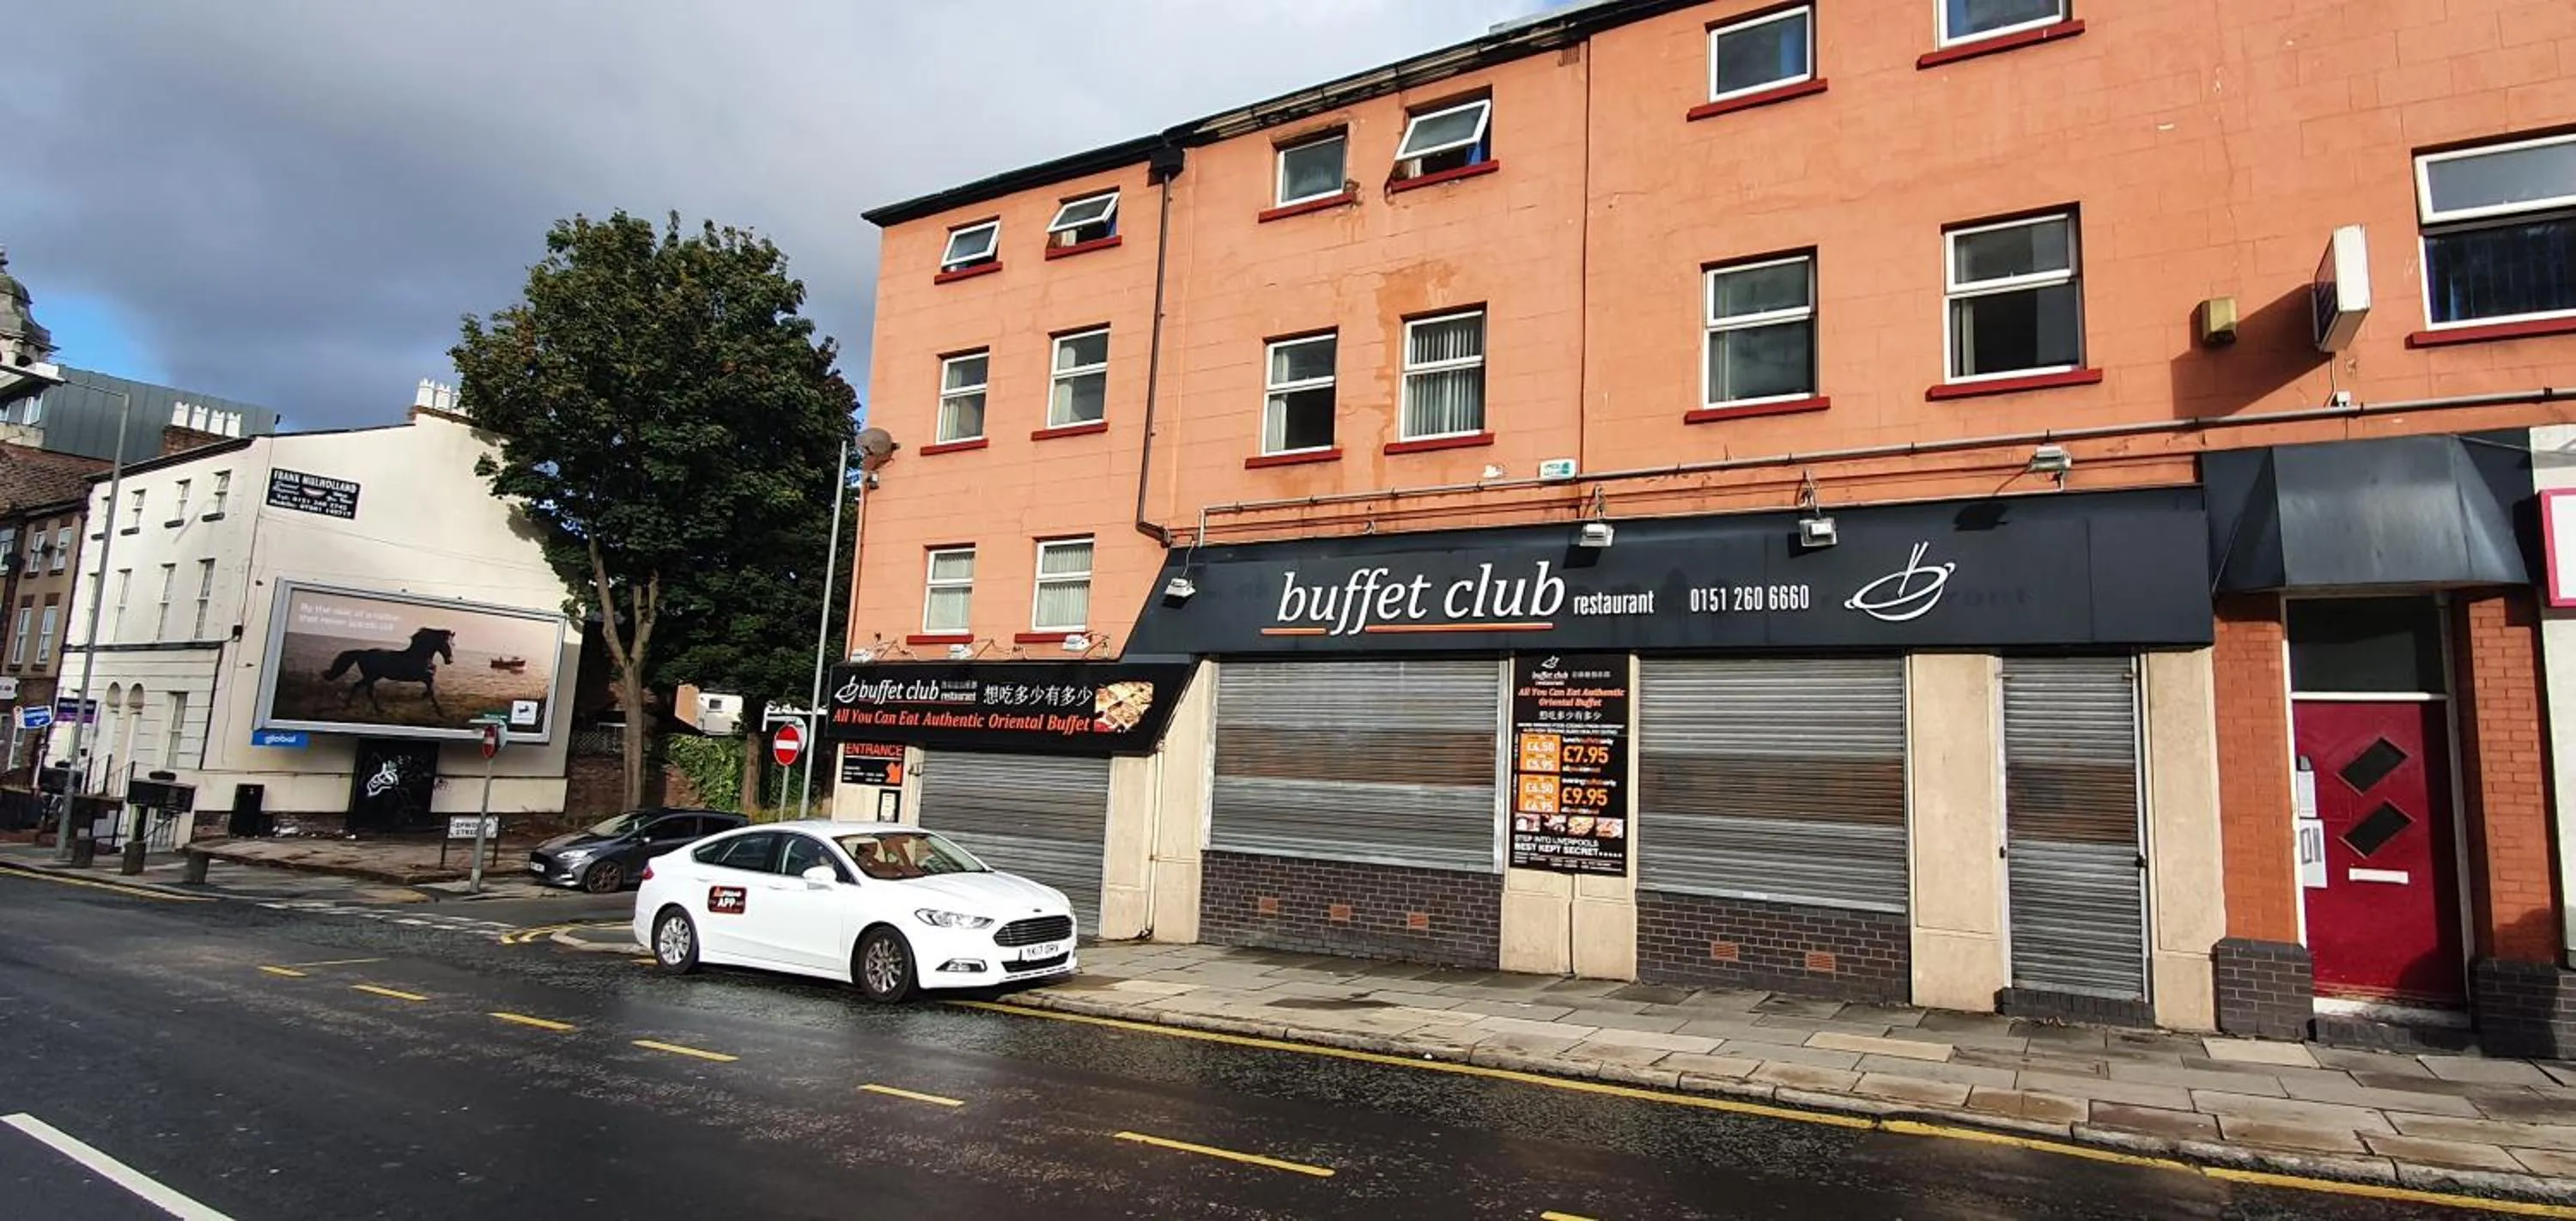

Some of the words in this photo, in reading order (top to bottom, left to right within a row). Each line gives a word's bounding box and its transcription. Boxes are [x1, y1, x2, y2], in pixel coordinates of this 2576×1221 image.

[1277, 567, 1432, 636] buffet
[1443, 560, 1566, 618] club
[1573, 590, 1655, 615] restaurant
[1690, 587, 1727, 612] 0151
[1733, 586, 1763, 611] 260
[1768, 584, 1809, 610] 6660
[860, 679, 904, 704] buffet
[906, 679, 939, 701] club
[983, 684, 1093, 706] 想吃多少有多少
[833, 708, 850, 723] All
[852, 709, 872, 724] You
[874, 710, 896, 725] Can
[898, 711, 919, 726] Eat
[921, 712, 985, 728] Authentic
[988, 714, 1044, 730] Oriental
[1047, 714, 1091, 736] Buffet
[845, 743, 904, 756] ENTRANCE
[1563, 745, 1609, 763] £7.95
[1562, 787, 1608, 806] £9.95
[1514, 842, 1536, 852] BEST
[1537, 844, 1562, 853] KEPT
